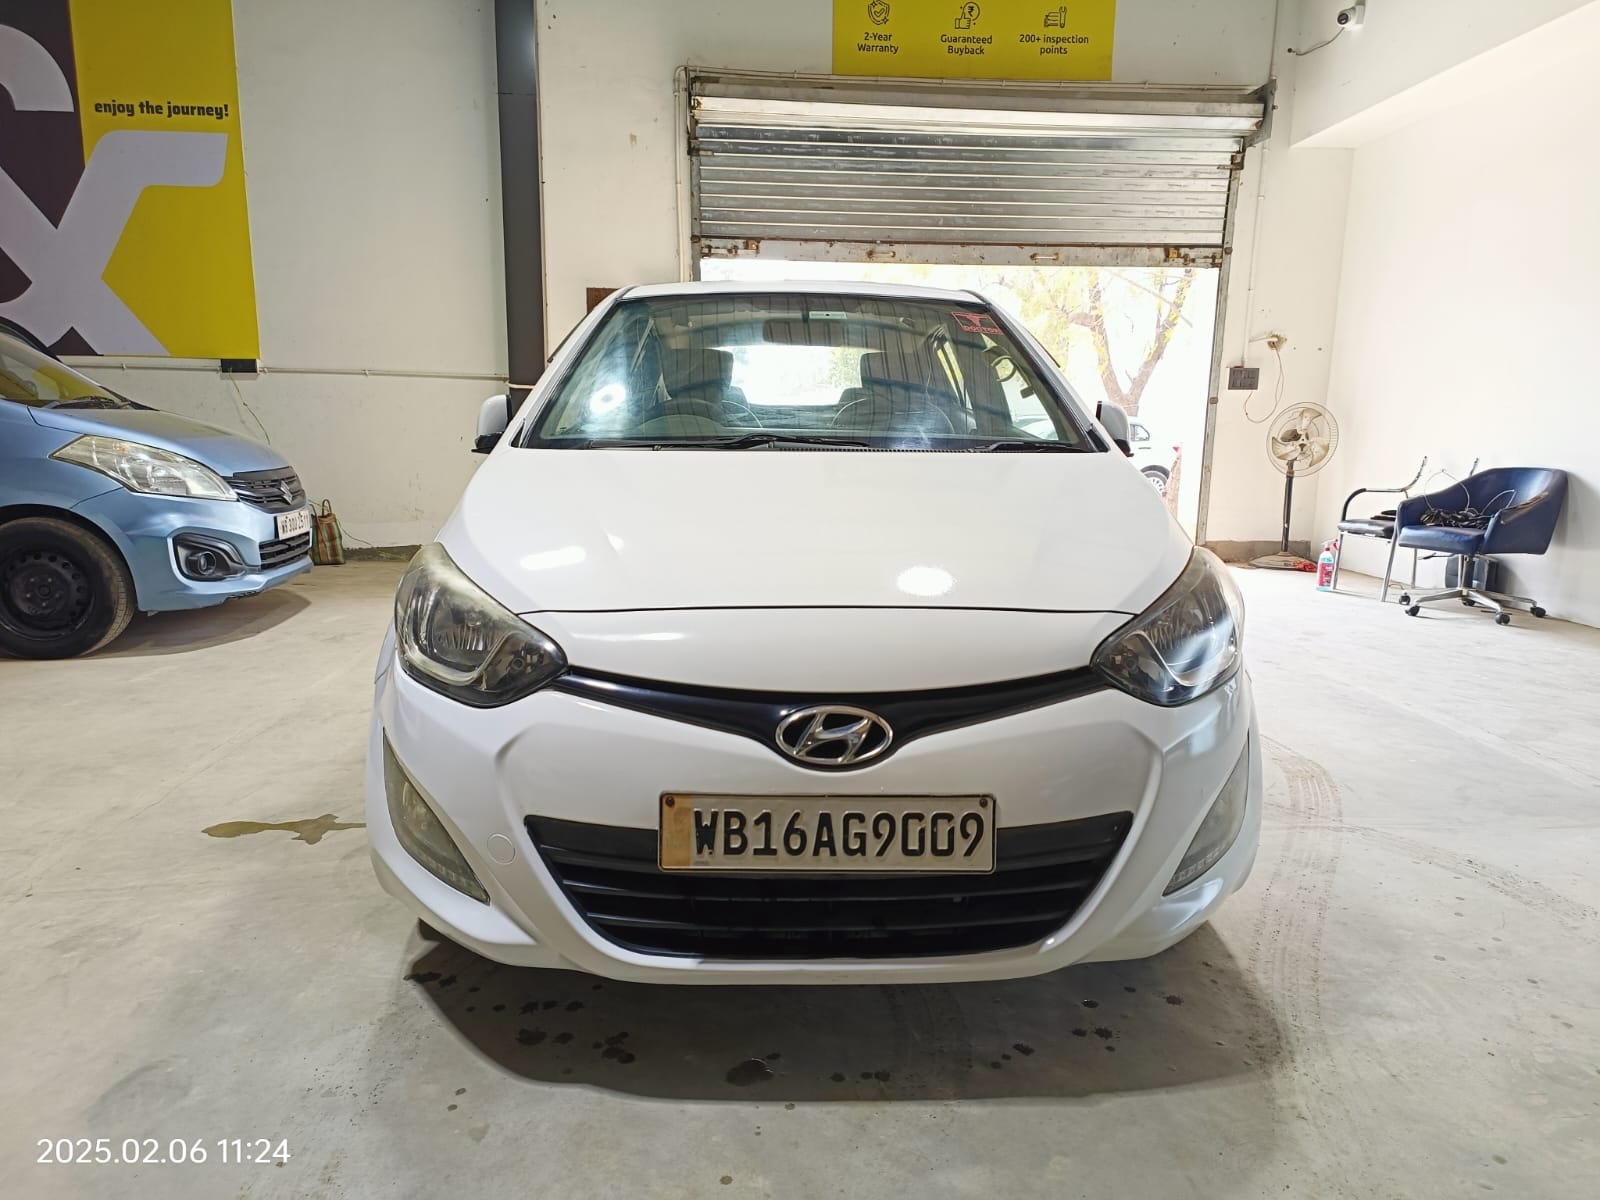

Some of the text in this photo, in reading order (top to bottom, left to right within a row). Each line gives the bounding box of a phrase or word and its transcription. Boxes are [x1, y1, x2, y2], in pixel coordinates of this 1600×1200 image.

[864, 32, 893, 42] 2-Year
[940, 34, 993, 45] Guaranteed
[1019, 34, 1089, 46] 200+ inspection
[857, 43, 899, 54] Warranty
[947, 45, 985, 56] Buyback
[1040, 45, 1068, 56] points
[94, 99, 229, 120] enjoy the journey!
[693, 809, 985, 858] WB16AG9009
